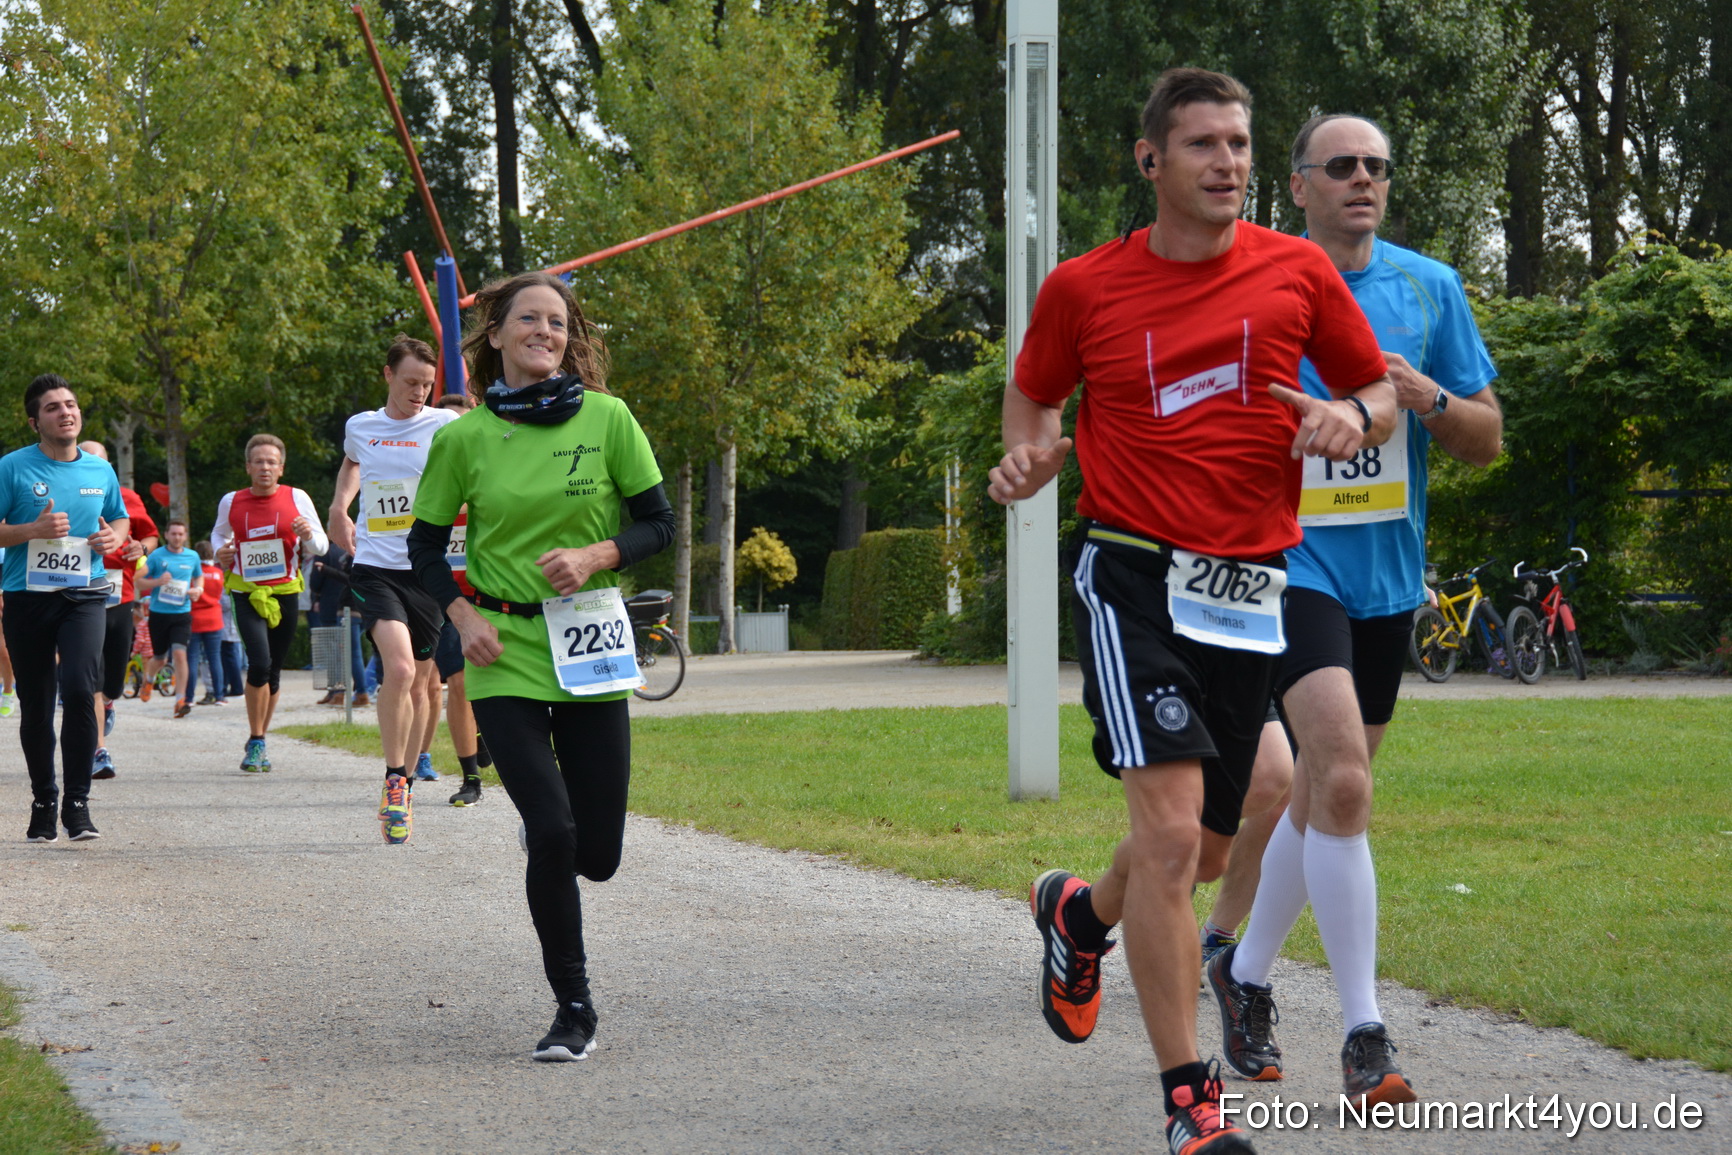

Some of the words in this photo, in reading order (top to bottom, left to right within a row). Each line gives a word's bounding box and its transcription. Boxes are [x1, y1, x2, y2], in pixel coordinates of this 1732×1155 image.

[1182, 377, 1216, 399] DEHN
[381, 440, 421, 448] KLEBL
[553, 446, 601, 458] LAUFMASCHE
[1317, 443, 1382, 481] 138
[568, 478, 594, 487] GISELA
[565, 489, 580, 497] THE
[582, 488, 598, 496] BEST
[1333, 491, 1369, 505] Alfred
[377, 496, 410, 515] 112
[386, 519, 406, 527] Marco
[37, 552, 81, 571] 2642
[247, 552, 278, 566] 2088
[48, 575, 68, 583] Malek
[1185, 557, 1271, 605] 2062
[1201, 609, 1246, 630] Thomas
[564, 619, 625, 657] 2232
[593, 662, 619, 675] Gisela
